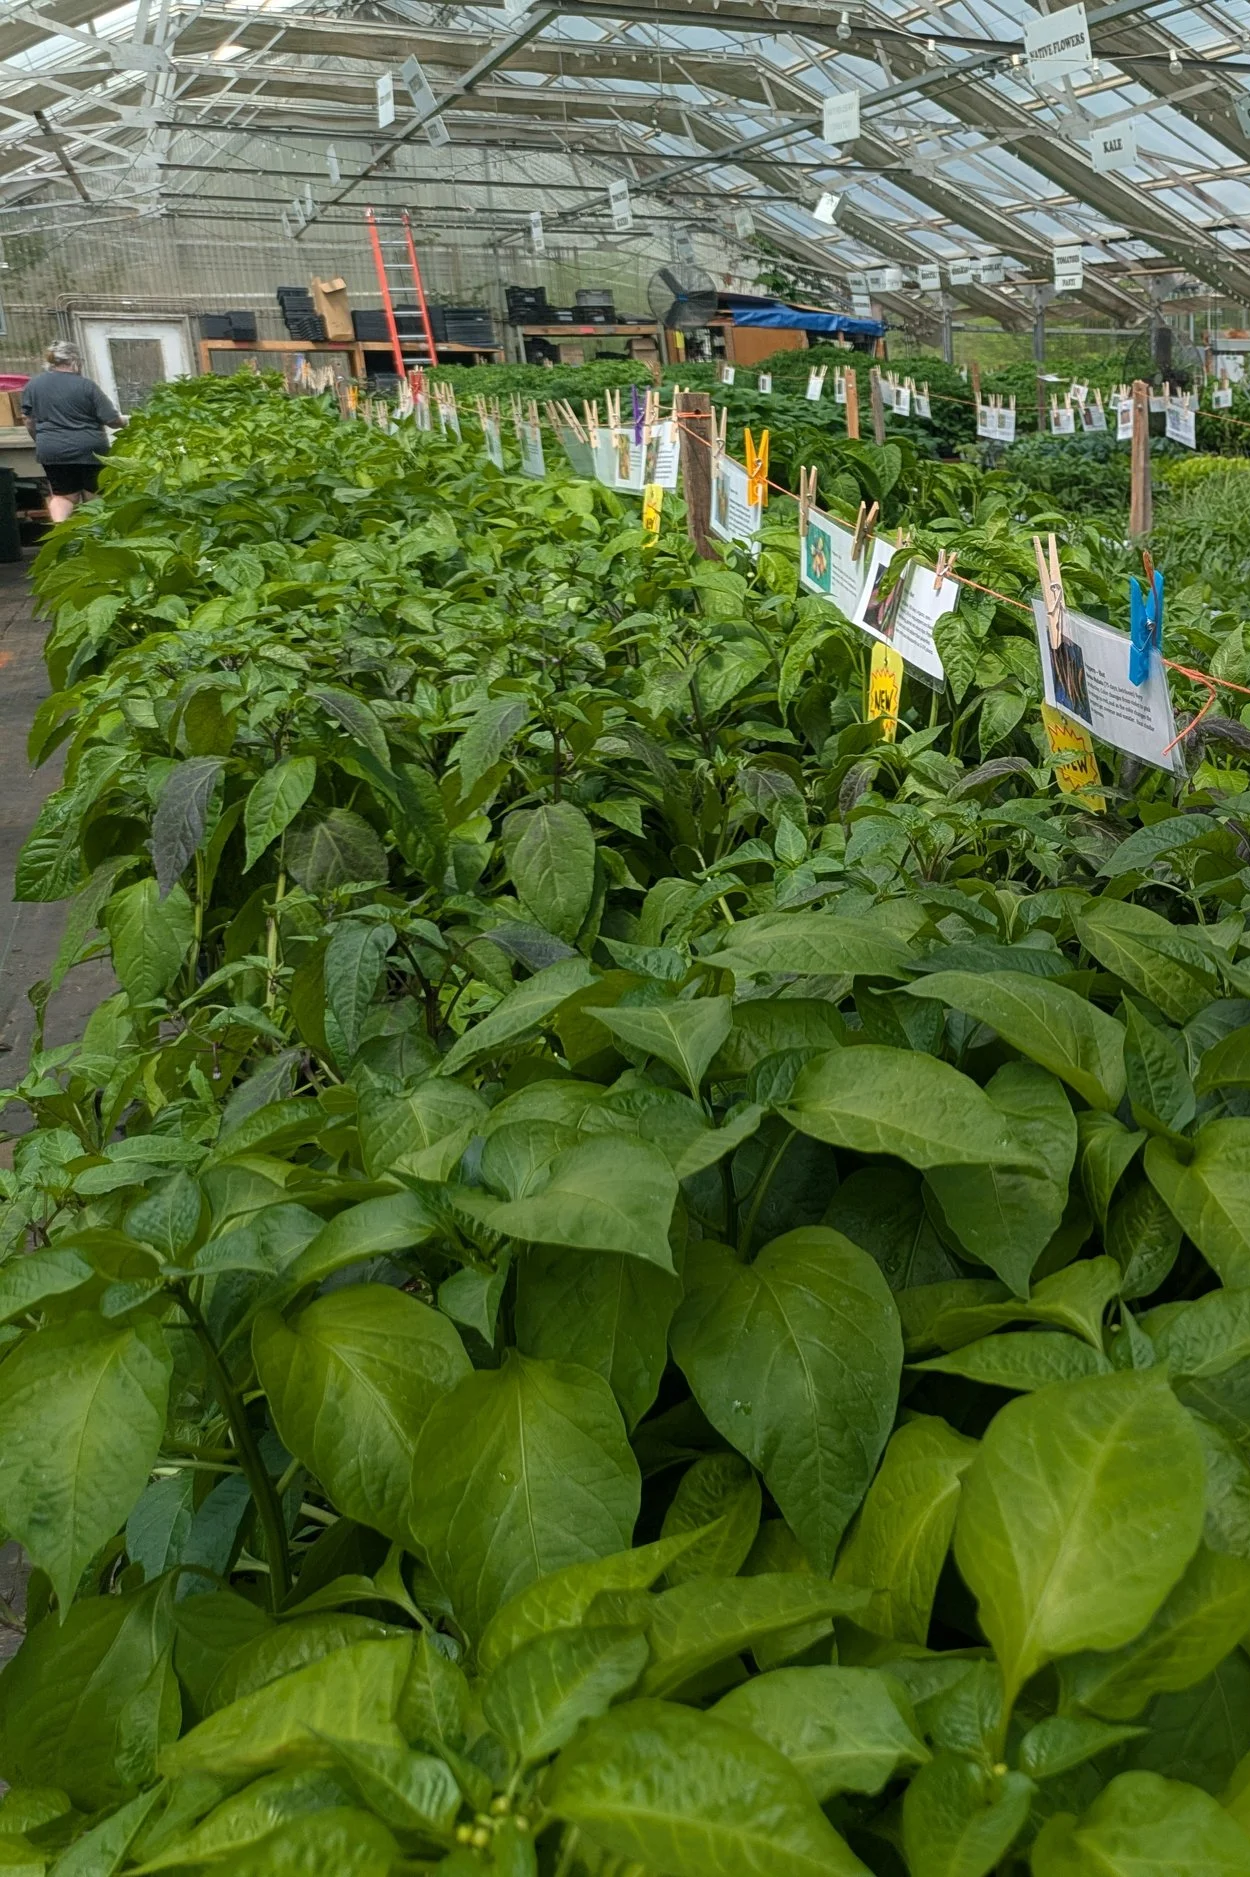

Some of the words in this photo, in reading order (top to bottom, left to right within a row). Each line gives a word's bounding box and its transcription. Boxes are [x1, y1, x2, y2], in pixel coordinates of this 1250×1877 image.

[1029, 43, 1053, 63] NATIVE
[1052, 32, 1086, 55] FLOWERS
[1103, 138, 1123, 153] KALE
[874, 689, 894, 711] NEW
